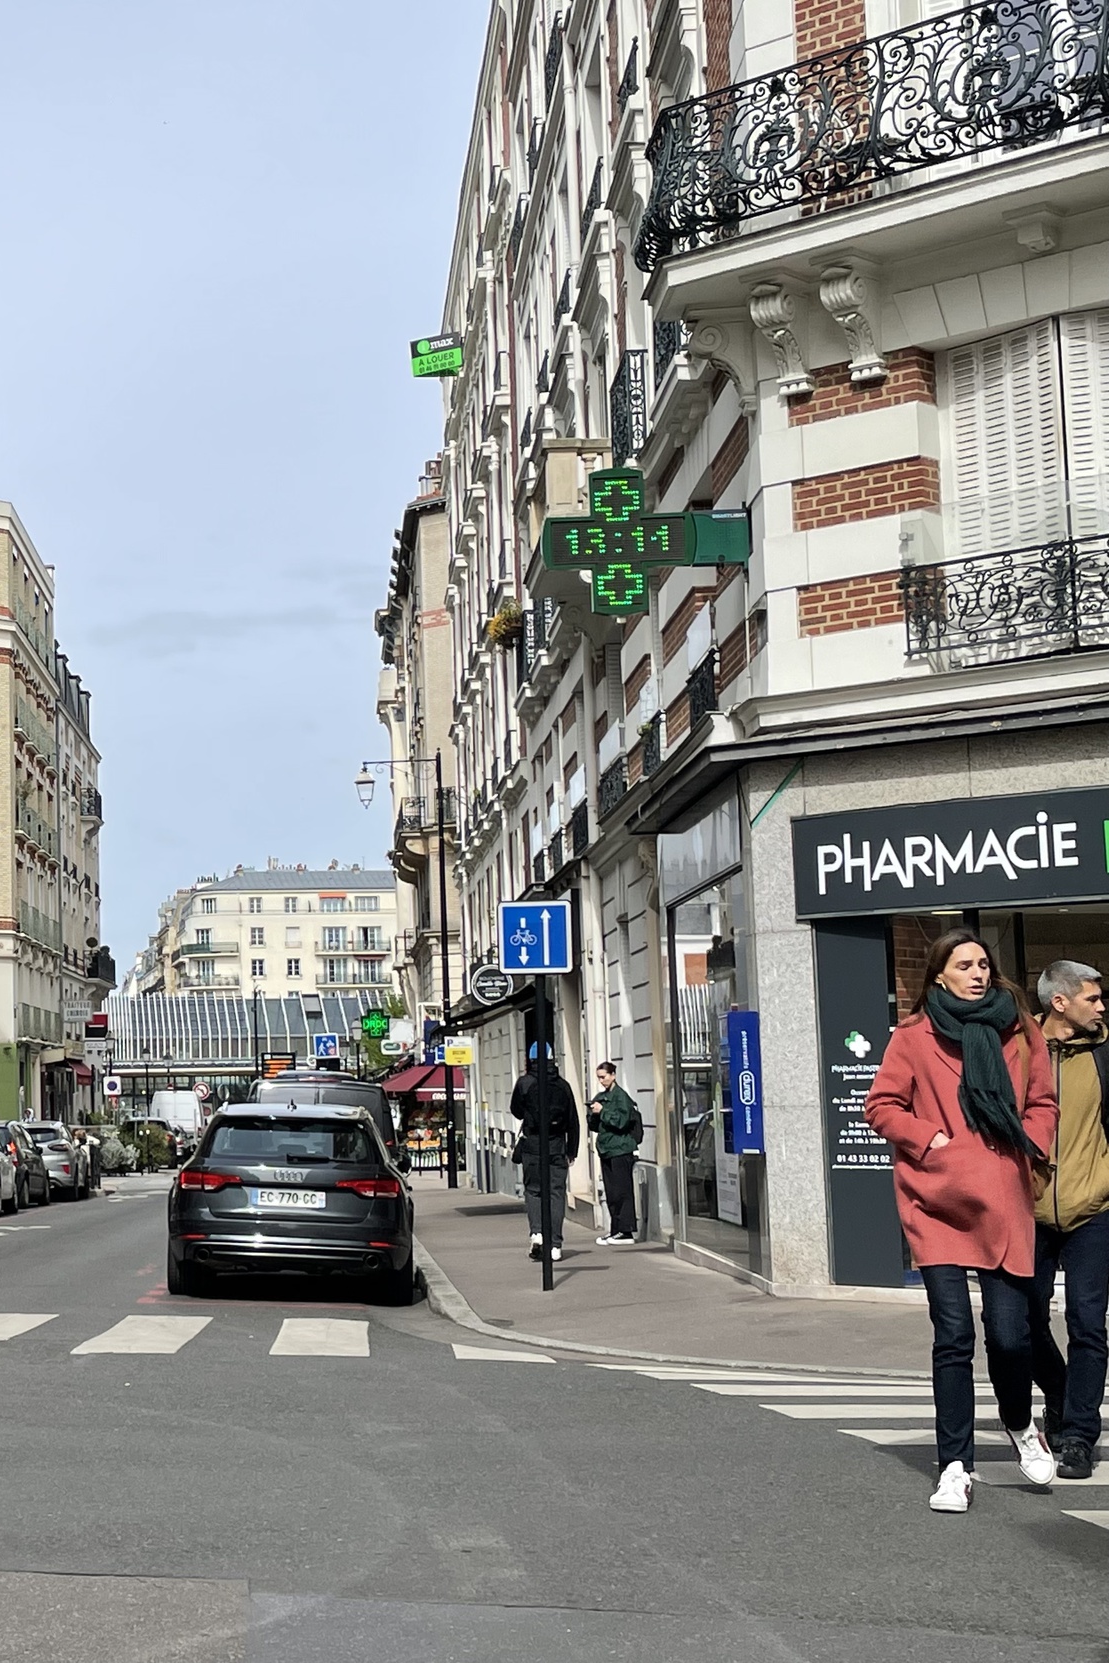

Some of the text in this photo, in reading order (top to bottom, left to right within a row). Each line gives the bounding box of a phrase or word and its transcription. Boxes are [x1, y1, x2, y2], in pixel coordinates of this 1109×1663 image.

[426, 351, 455, 365] LOUER
[816, 810, 1080, 896] PHARMACIE
[742, 1074, 751, 1102] durex
[837, 1154, 890, 1162] 01 43 33 02 02
